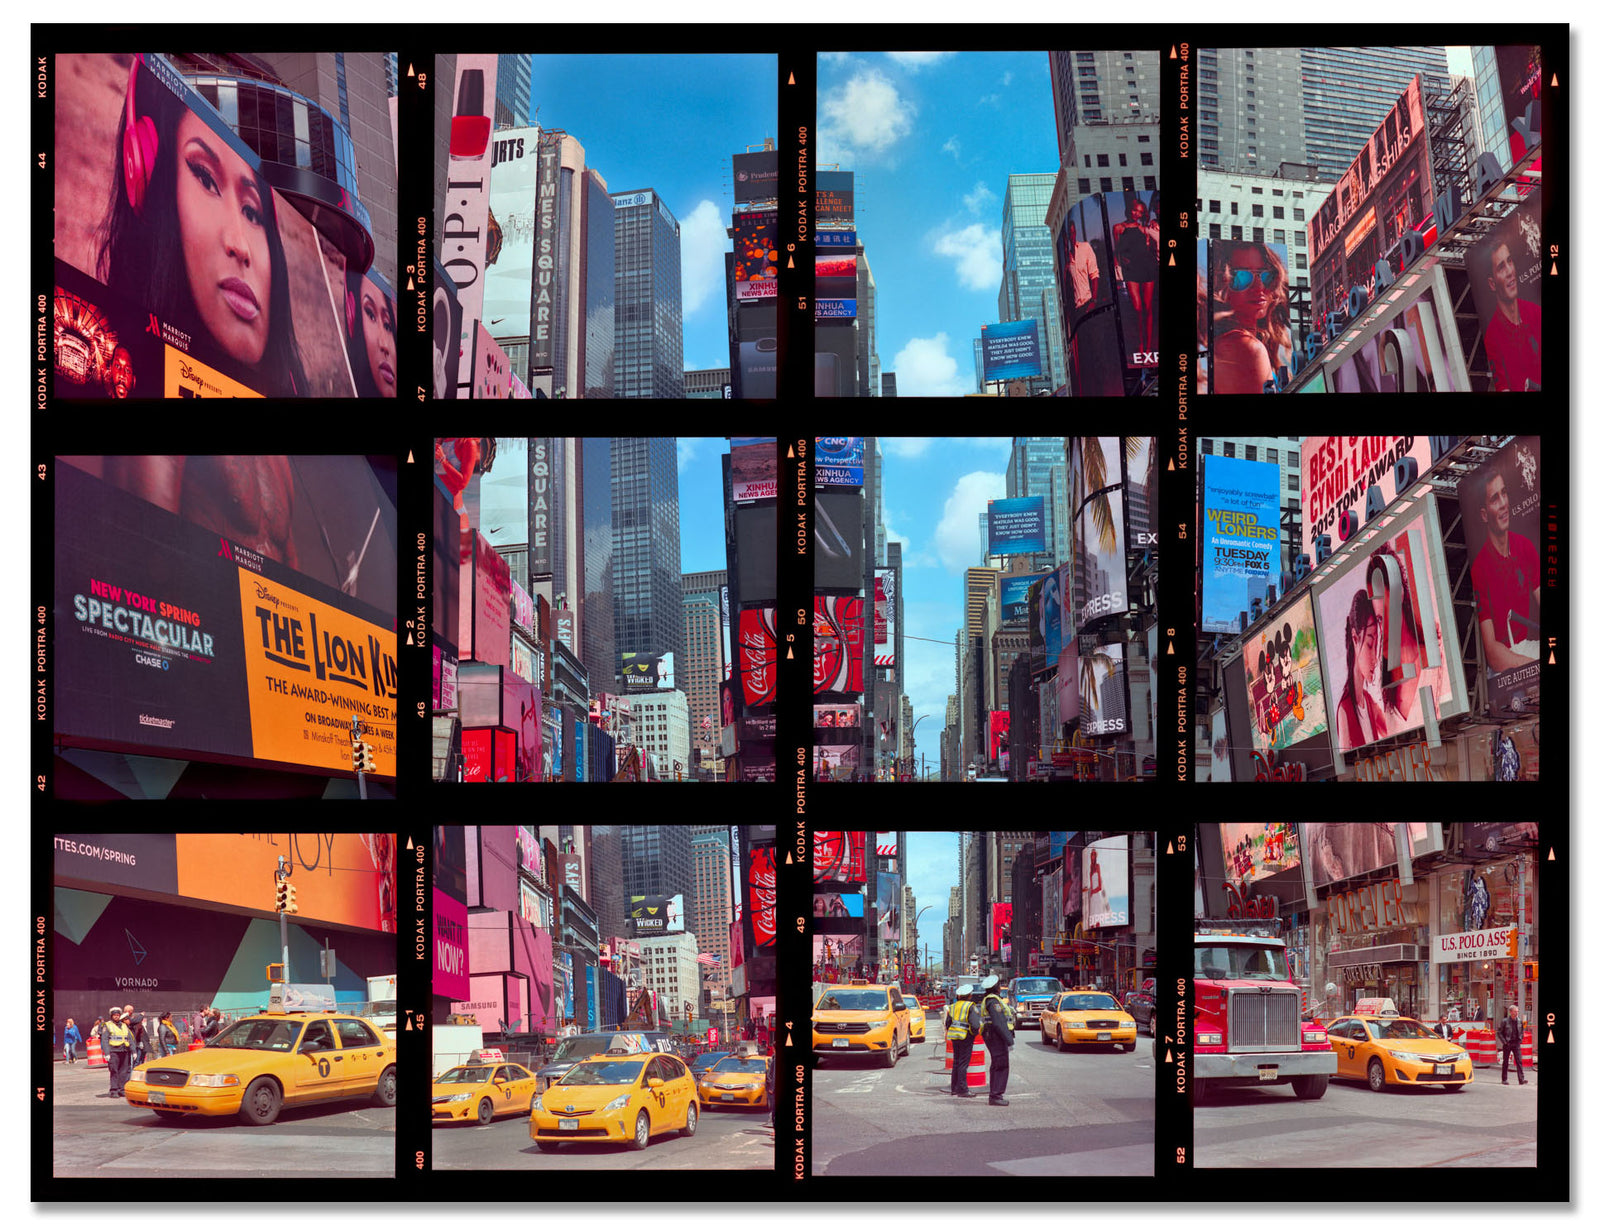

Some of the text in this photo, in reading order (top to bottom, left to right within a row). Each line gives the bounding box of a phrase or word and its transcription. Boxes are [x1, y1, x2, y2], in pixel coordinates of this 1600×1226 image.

[38, 57, 46, 97] KODAK
[418, 73, 426, 89] 48
[1180, 43, 1188, 157] KODAK PORTRA 400
[38, 153, 46, 168] 44
[799, 127, 807, 241] KODAK PORTRA 400
[833, 205, 852, 213] MEET
[1180, 212, 1188, 227] 55
[536, 153, 556, 340] TIMES SQUARE
[787, 243, 795, 252] 6
[1168, 239, 1176, 248] 9
[1550, 244, 1559, 258] 12
[407, 265, 415, 275] 3
[417, 217, 426, 331] KODAK PORTRA 400
[799, 297, 807, 309] 51
[162, 322, 192, 343] MARRIOTT
[162, 332, 189, 351] MARQUIS
[38, 295, 46, 409] KODAK PORTRA 400
[418, 386, 426, 401] 47
[1179, 354, 1187, 468] KODAK PORTRA 400
[38, 464, 46, 480] 43
[1309, 436, 1343, 493] BEST
[815, 469, 852, 478] XINHUA
[531, 444, 552, 548] SQUARE
[798, 440, 806, 554] KODAK PORTRA 400
[1309, 458, 1349, 523] CYNDI
[1310, 436, 1414, 545] 2013 TONY AWARD
[1206, 508, 1259, 526] WEIRD
[1179, 524, 1187, 538] 54
[1215, 520, 1278, 540] LONERS
[1211, 536, 1273, 551] An Unromantic Comedy
[234, 545, 265, 564] MARRIOTT
[1214, 546, 1270, 561] TUESDAY
[235, 555, 262, 572] MARQUIS
[1245, 560, 1262, 569] FOX
[1263, 561, 1270, 570] 5
[253, 581, 280, 610] Disney
[417, 533, 425, 647] KODAK PORTRA 400
[90, 578, 201, 627] NEW YORK SPRING
[1081, 591, 1123, 624] EXPRESS
[798, 609, 806, 624] 50
[73, 593, 215, 658] SPECTACULAR
[82, 625, 108, 638] LIVE FROM
[406, 621, 414, 630] 2
[1167, 628, 1175, 637] 8
[255, 606, 367, 681] THE LION
[787, 634, 795, 642] 5
[1549, 638, 1557, 652] 11
[38, 606, 46, 720] KODAK PORTRA 400
[135, 654, 162, 669] CHASE
[1497, 675, 1513, 689] LIVE
[265, 676, 390, 720] THE AWARD-WINNING BEST
[417, 702, 425, 718] 46
[305, 712, 352, 731] ON BROADWAY
[1086, 718, 1125, 734] EXPRESS
[1178, 667, 1186, 781] KODAK PORTRA 400
[37, 775, 46, 791] 42
[797, 748, 805, 862] KODAK PORTRA 400
[1178, 836, 1186, 851] 53
[416, 846, 424, 959] KODAK PORTRA 400
[1326, 878, 1407, 936] FOREVER
[636, 918, 663, 927] WICKED
[797, 917, 805, 933] 49
[1088, 911, 1126, 927] EXPRESS
[436, 913, 463, 946] WANT IT
[1441, 936, 1458, 951] U.S.
[1458, 933, 1485, 950] POLO
[437, 939, 464, 977] NOW?
[1457, 949, 1498, 960] SINCE 1890
[37, 917, 45, 1030] KODAK PORTRA 400
[114, 977, 159, 987] VORNADO
[461, 1001, 498, 1011] SAMSUNG
[416, 1014, 424, 1030] 45
[786, 1021, 794, 1030] 4
[1547, 1013, 1556, 1027] 10
[1165, 1036, 1173, 1044] 7
[1177, 979, 1185, 1092] KODAK PORTRA 400
[37, 1088, 45, 1101] 41
[795, 1065, 804, 1179] KODAK PORTRA 400
[416, 1151, 424, 1169] 400
[1177, 1147, 1185, 1163] 52
